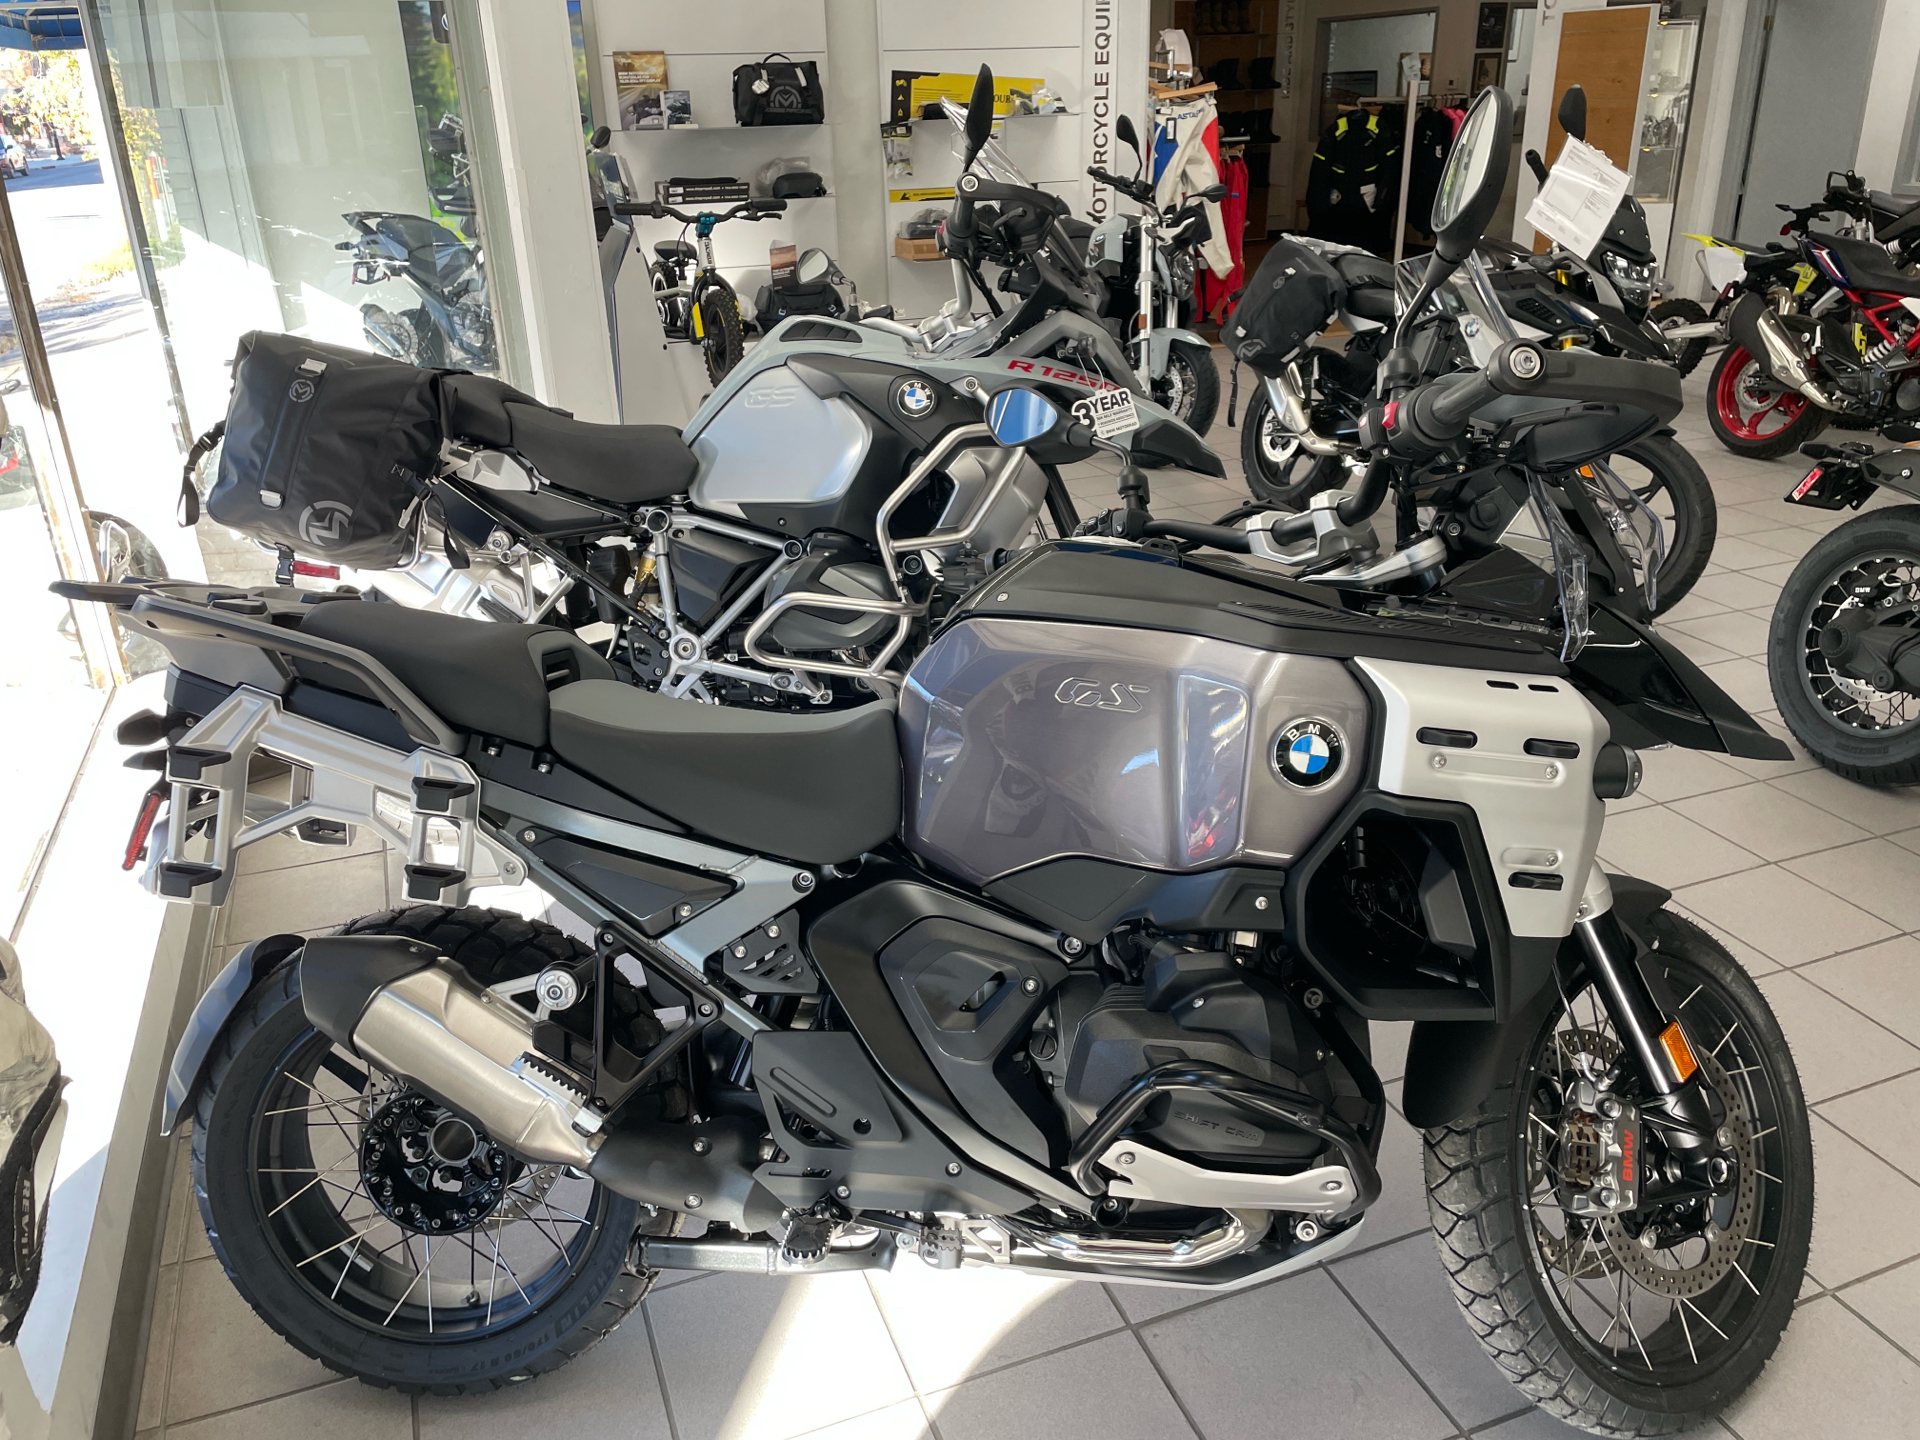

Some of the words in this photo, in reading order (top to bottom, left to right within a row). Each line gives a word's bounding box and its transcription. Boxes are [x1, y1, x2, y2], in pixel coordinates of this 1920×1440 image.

[1007, 359, 1035, 373] R
[903, 382, 932, 396] BMW
[1074, 402, 1096, 430] 3
[1089, 391, 1130, 413] YEAR
[1287, 723, 1339, 748] BMW
[1174, 1111, 1219, 1130] SHIFT
[1622, 1129, 1634, 1181] BMW
